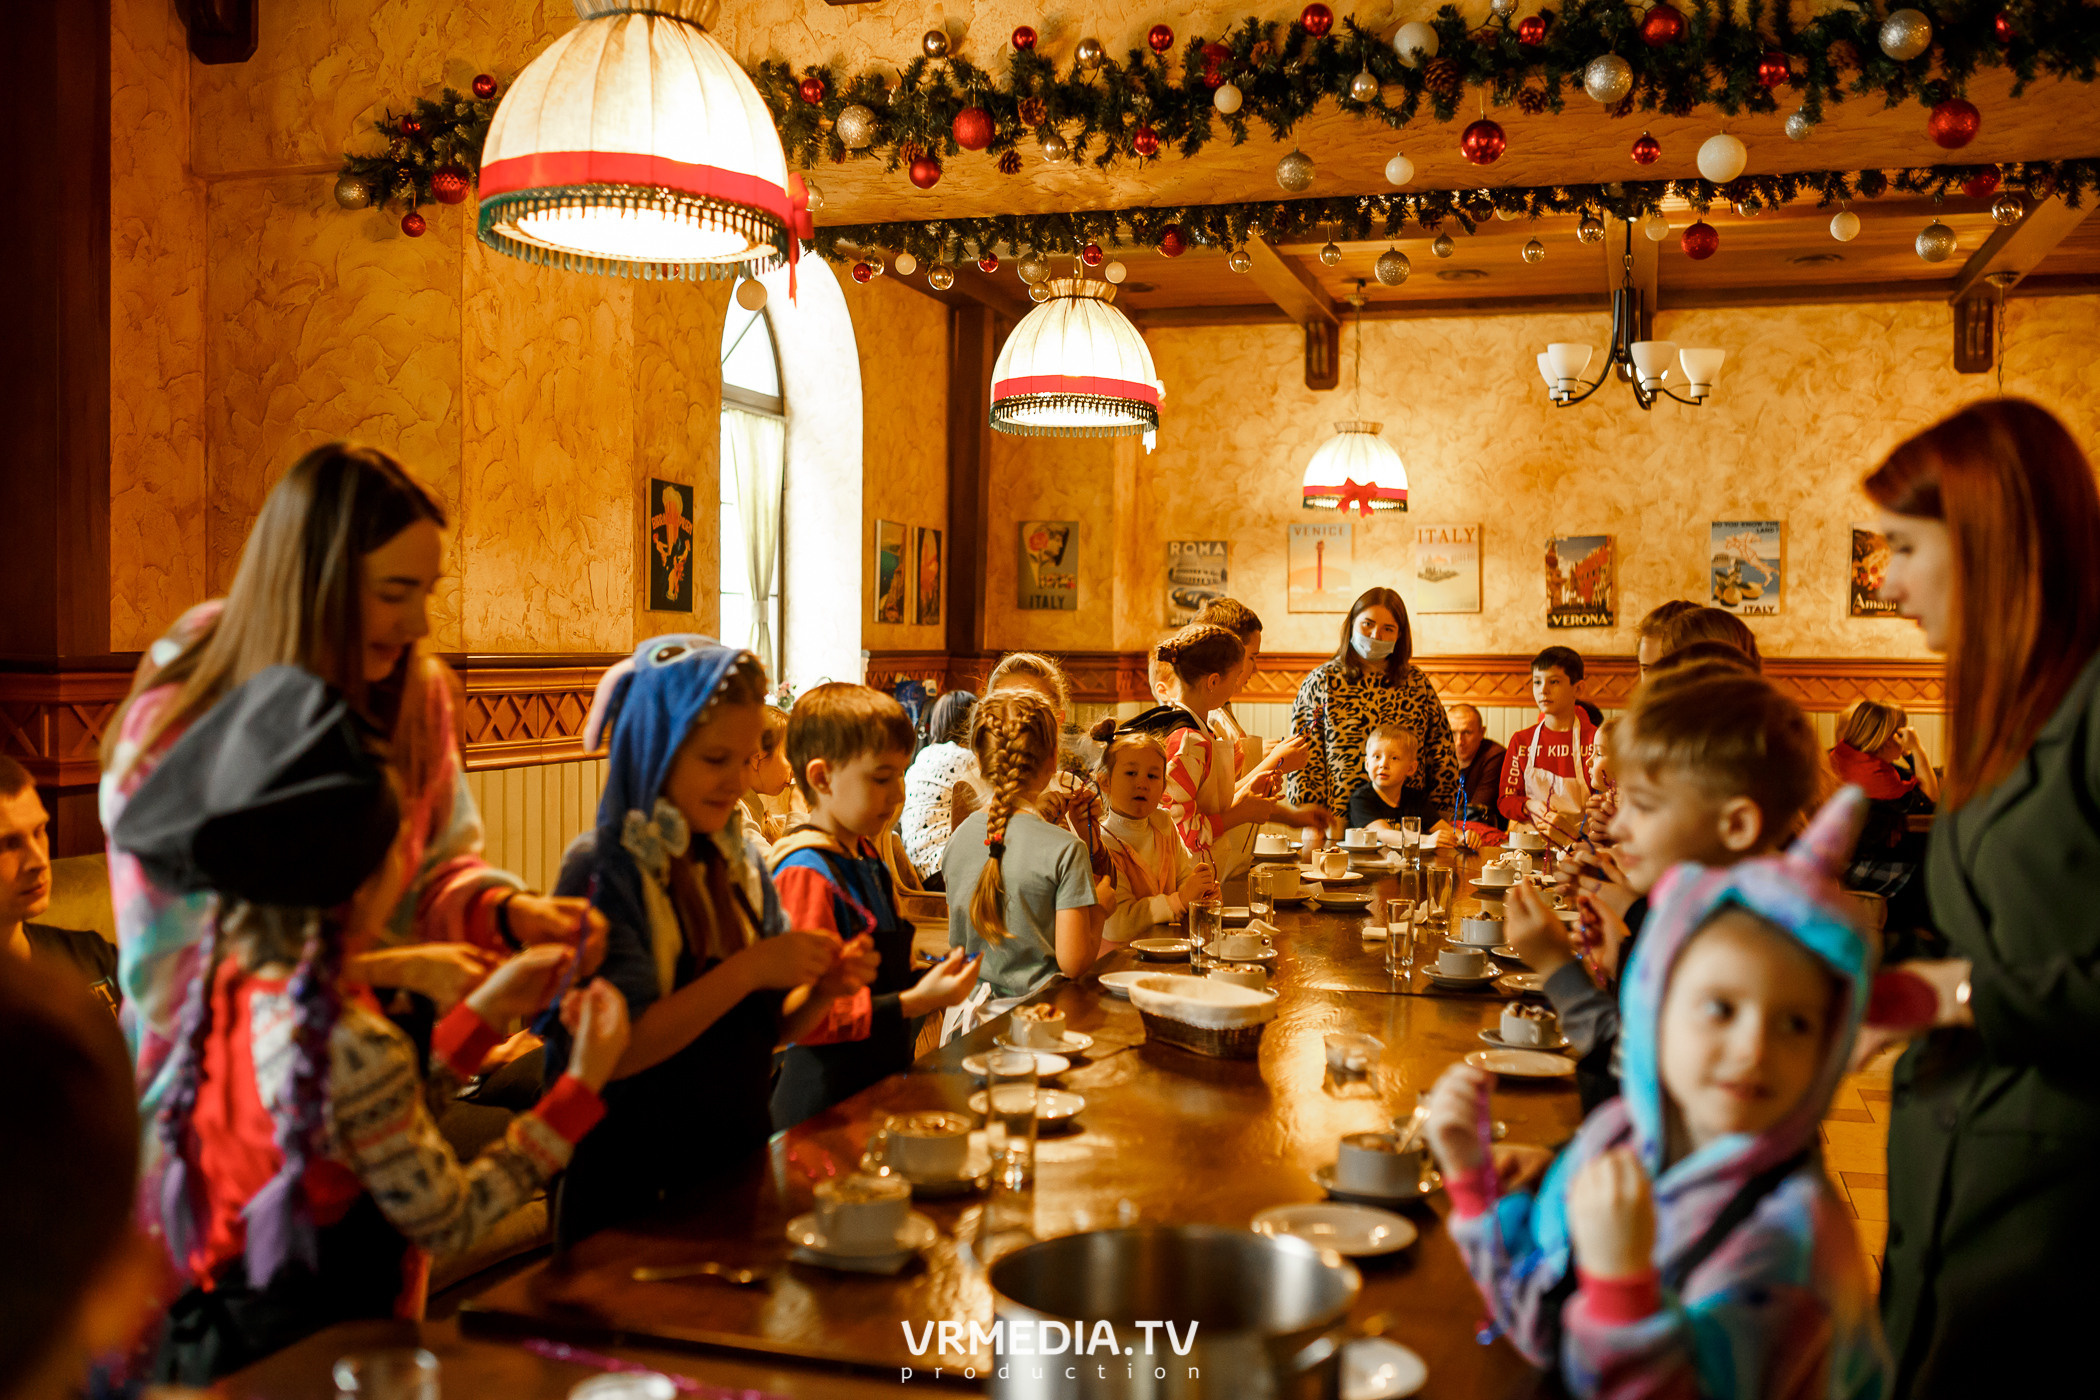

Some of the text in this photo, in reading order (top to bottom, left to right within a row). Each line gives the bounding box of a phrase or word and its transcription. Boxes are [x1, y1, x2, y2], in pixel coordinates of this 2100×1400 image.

[1417, 527, 1476, 545] ITALY
[1169, 541, 1226, 556] ROMA
[1029, 595, 1065, 610] ITALY
[1743, 604, 1775, 615] ITALY
[1551, 612, 1609, 626] VERONA
[1547, 744, 1570, 758] KID
